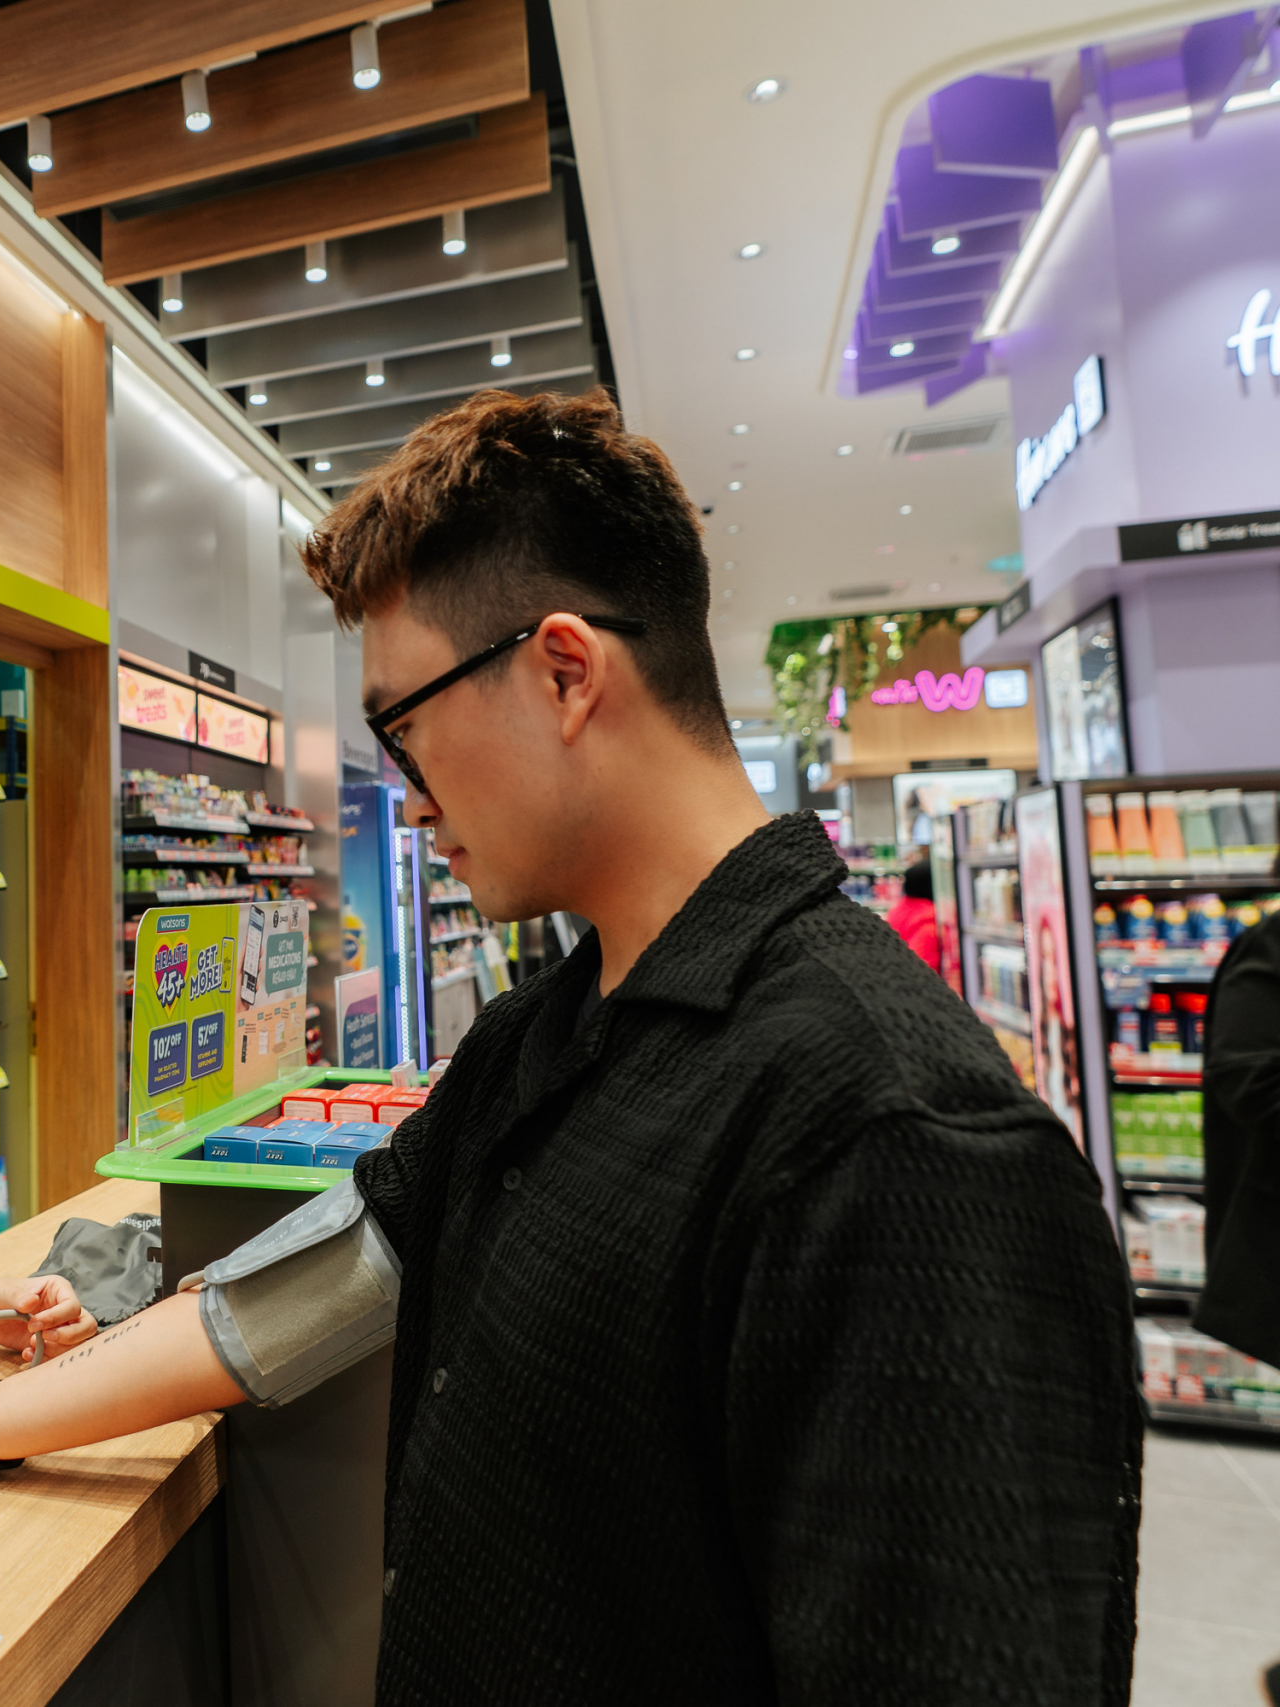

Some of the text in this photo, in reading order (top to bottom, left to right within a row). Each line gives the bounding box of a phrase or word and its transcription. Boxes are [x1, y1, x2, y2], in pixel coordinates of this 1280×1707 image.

[143, 686, 166, 701] sweet
[136, 703, 167, 723] treats
[160, 918, 186, 929] watsons
[154, 943, 189, 973] HEALTH
[197, 943, 219, 971] GET
[268, 951, 301, 969] MEDICATIONS
[157, 970, 185, 1006] 45+
[153, 1032, 182, 1062] 10% OFF
[197, 1025, 210, 1048] 5%
[208, 1022, 218, 1034] OFF
